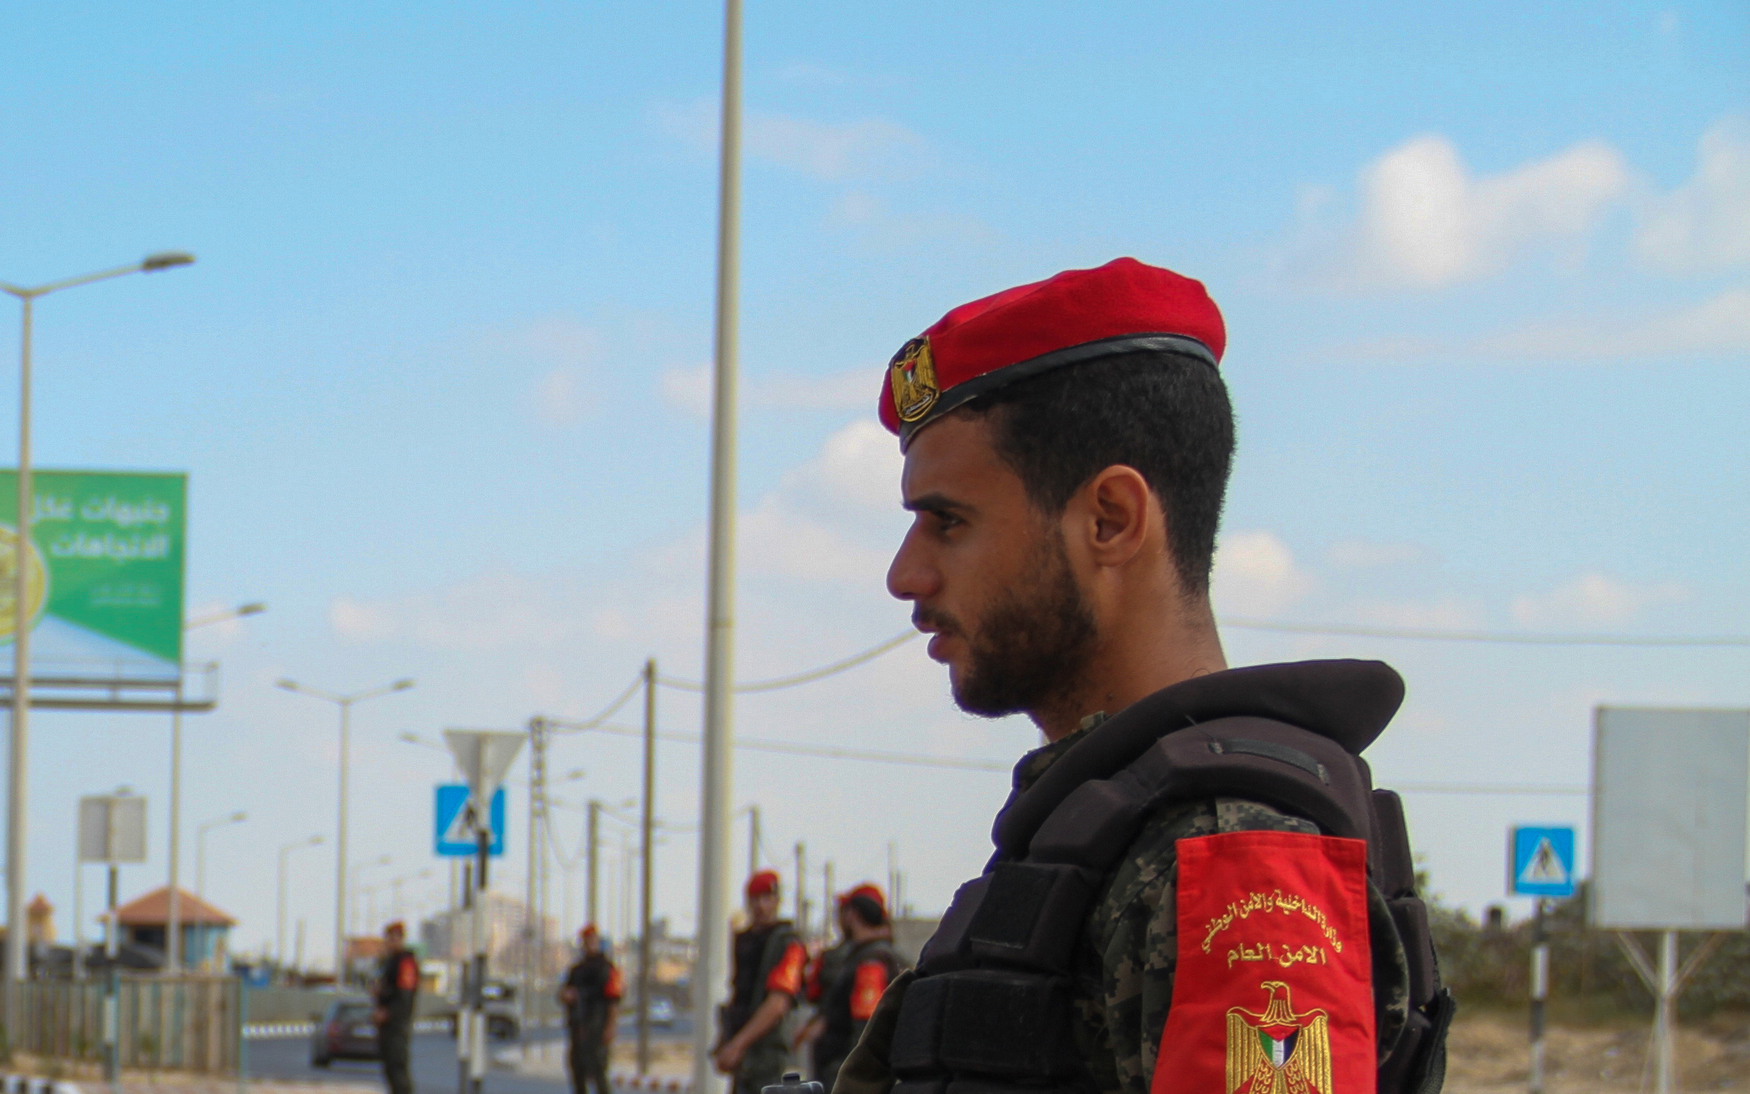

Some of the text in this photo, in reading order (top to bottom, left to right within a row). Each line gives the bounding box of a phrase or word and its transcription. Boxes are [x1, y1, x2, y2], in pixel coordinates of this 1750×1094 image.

[1274, 888, 1321, 924] الداخلية
[1202, 901, 1238, 954] الوطني
[1321, 913, 1343, 953] وزارة
[1227, 942, 1271, 970] العام
